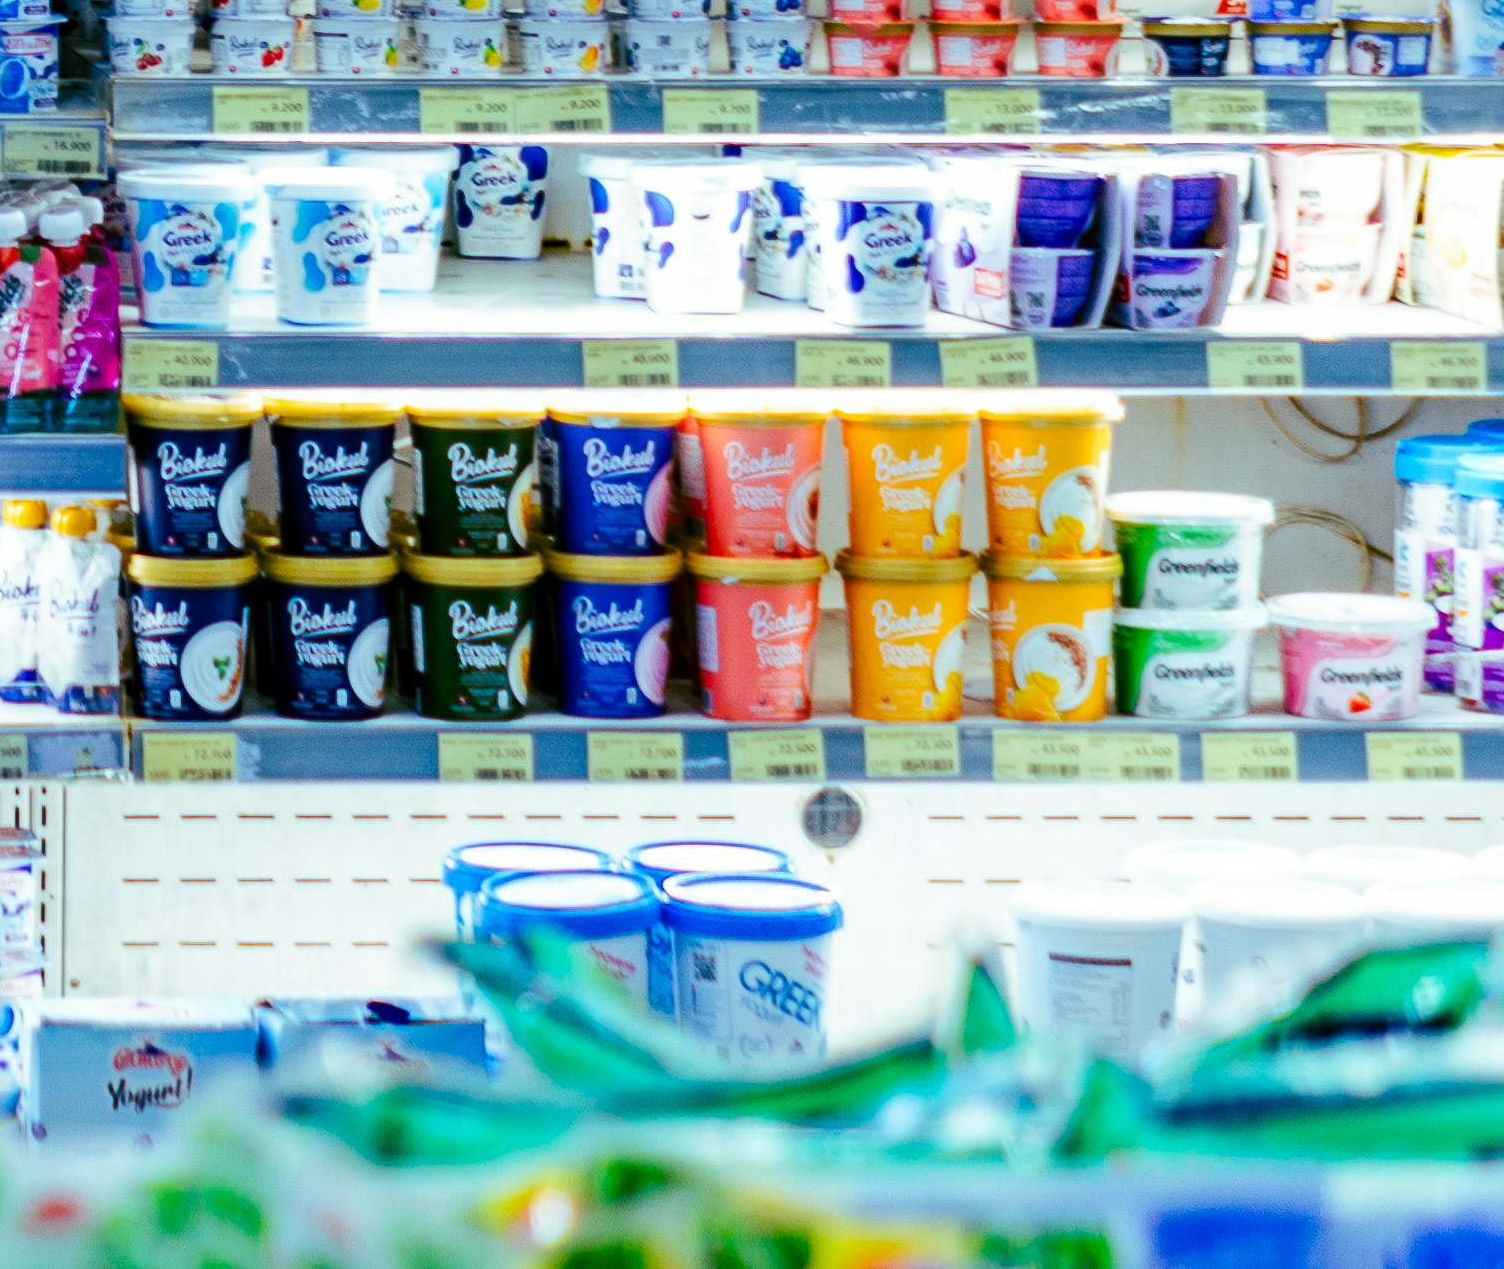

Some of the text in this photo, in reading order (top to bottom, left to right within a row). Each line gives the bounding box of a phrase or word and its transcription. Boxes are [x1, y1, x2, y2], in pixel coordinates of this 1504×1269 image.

[471, 172, 517, 188] Greek
[163, 231, 213, 247] Greek
[325, 231, 369, 247] Greek
[865, 233, 913, 248] Greek
[158, 441, 227, 482] Biokul
[299, 440, 369, 481] Biokul
[447, 442, 517, 482] Biokul
[583, 438, 655, 478] Biokul
[724, 441, 795, 481] Biokul
[872, 443, 943, 482] Biokul
[288, 597, 356, 638] Biokul
[448, 601, 518, 640] Biokul
[572, 596, 643, 636] Biokul
[749, 601, 812, 640] Biokul
[872, 600, 943, 639] Biokul
[108, 1066, 193, 1112] Yogurt!
